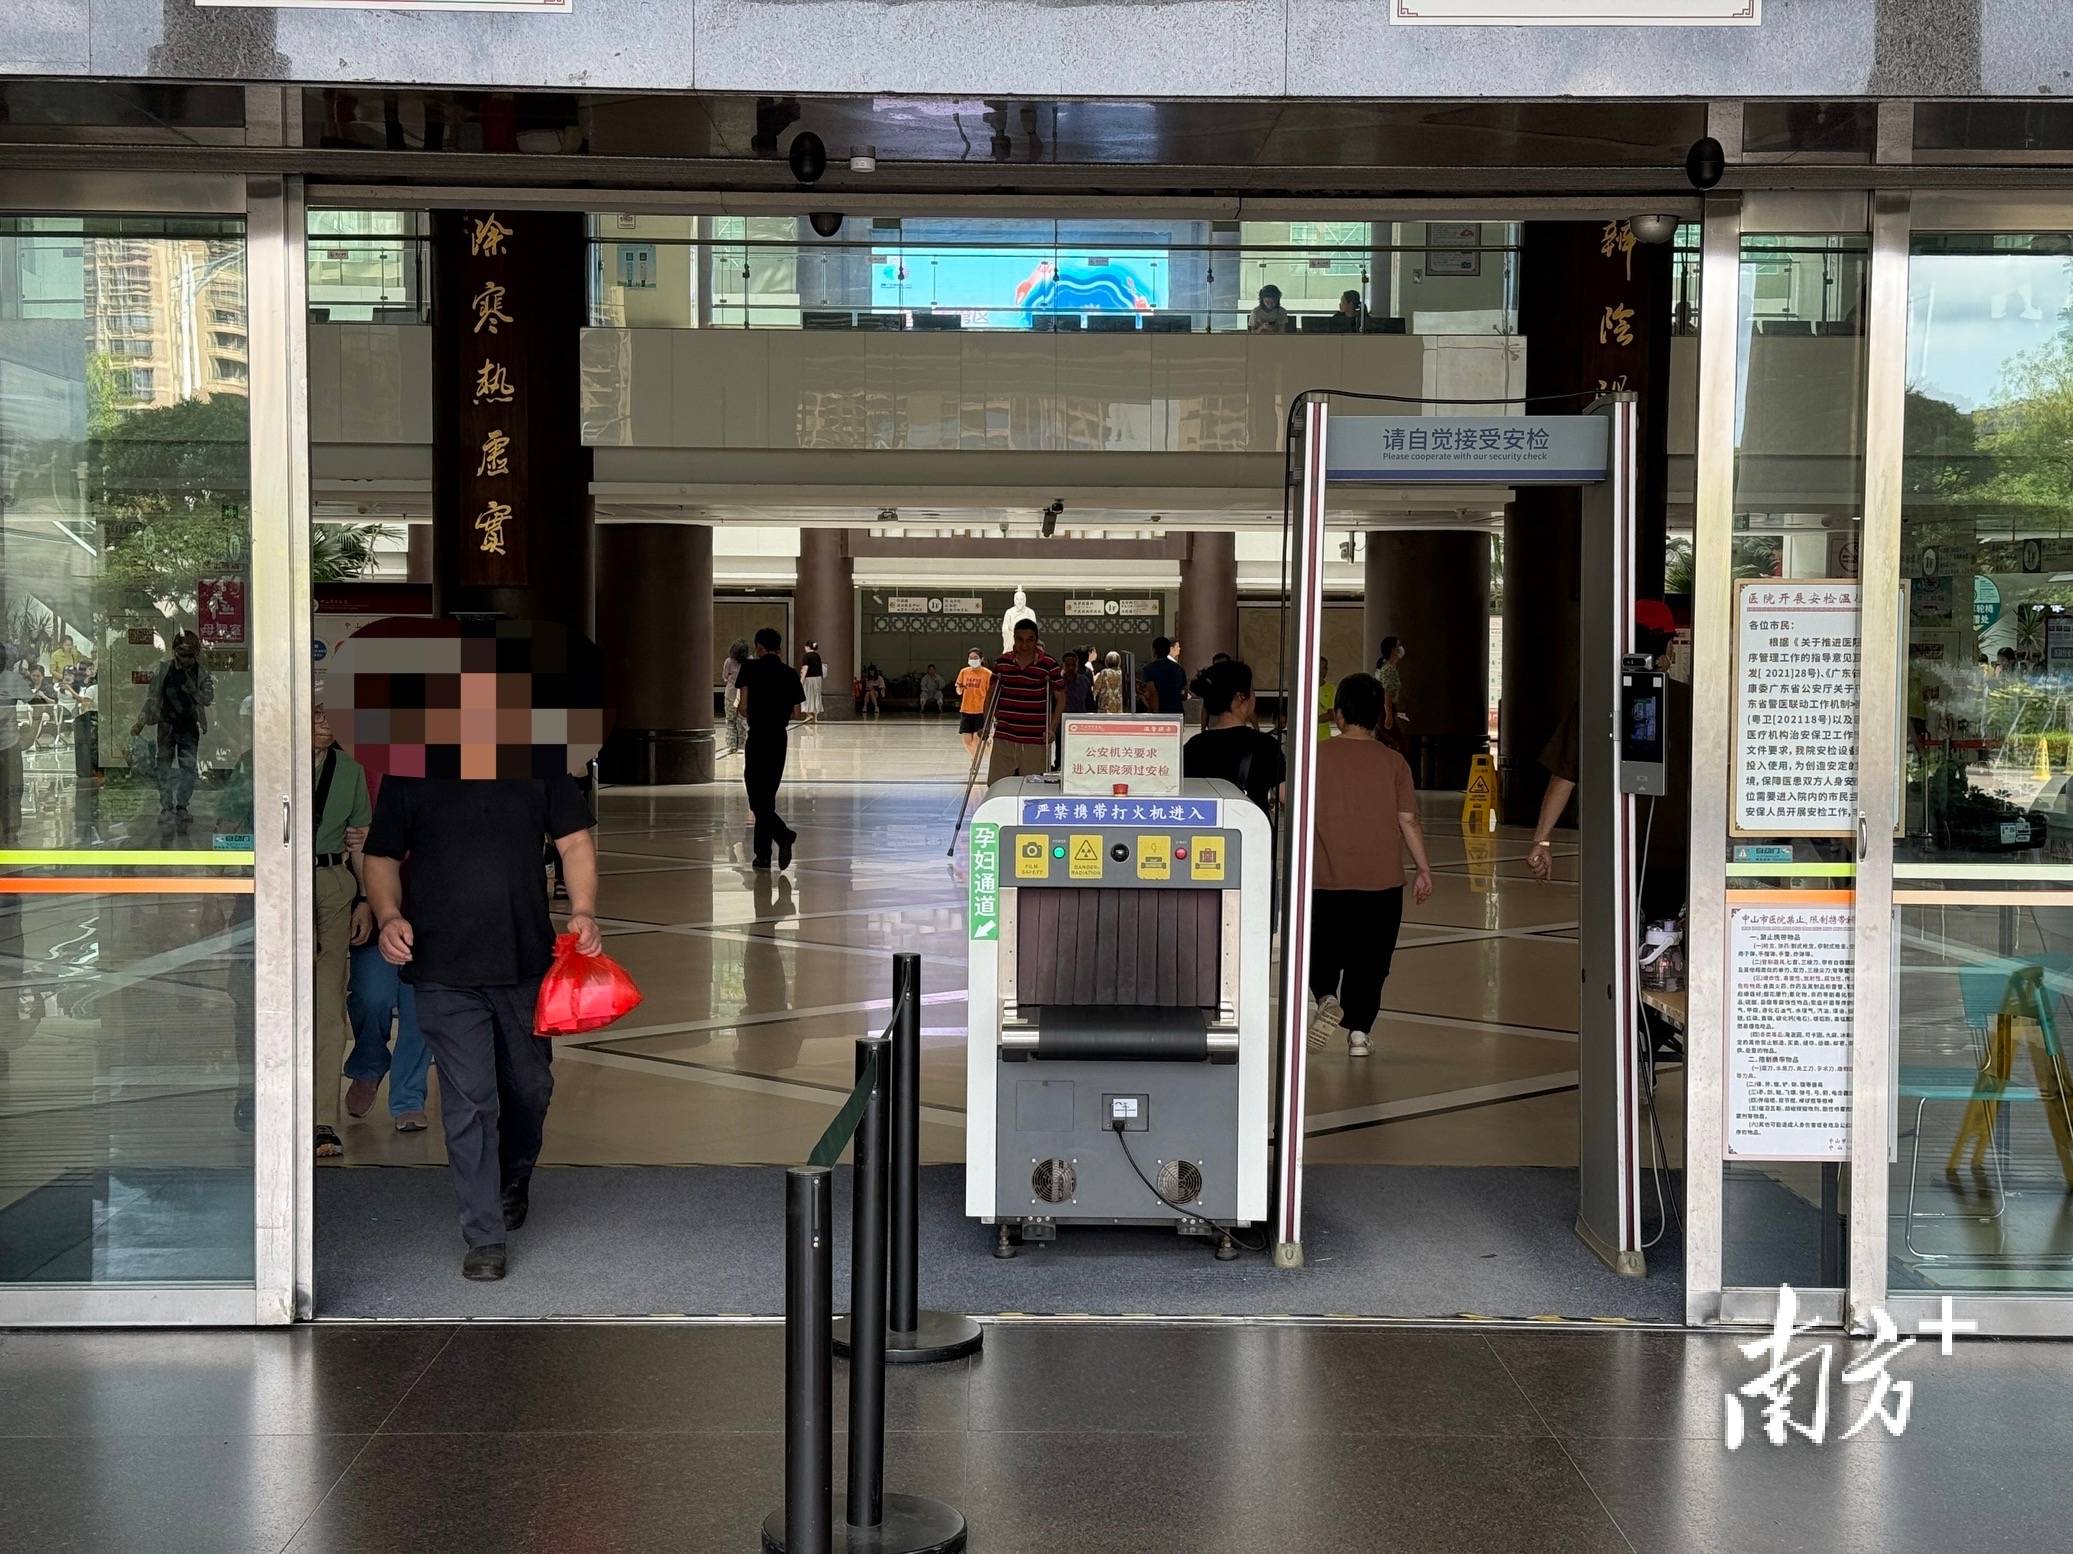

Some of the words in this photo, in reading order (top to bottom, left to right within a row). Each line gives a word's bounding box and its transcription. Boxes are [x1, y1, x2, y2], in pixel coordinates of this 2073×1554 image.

[1382, 428, 1550, 450] 请自觉接受安检
[1383, 452, 1410, 461] Please
[1411, 453, 1451, 462] cooperate
[1453, 452, 1471, 461] with
[1488, 452, 1521, 462] security
[1523, 452, 1547, 461] check
[1749, 620, 1795, 631] 各位市民：
[1085, 747, 1158, 759] 公安机关要求
[1072, 763, 1170, 777] 进入医院须过安检
[1034, 803, 1205, 821] 严禁携带打火机进入
[974, 827, 996, 917] 孕妇通道
